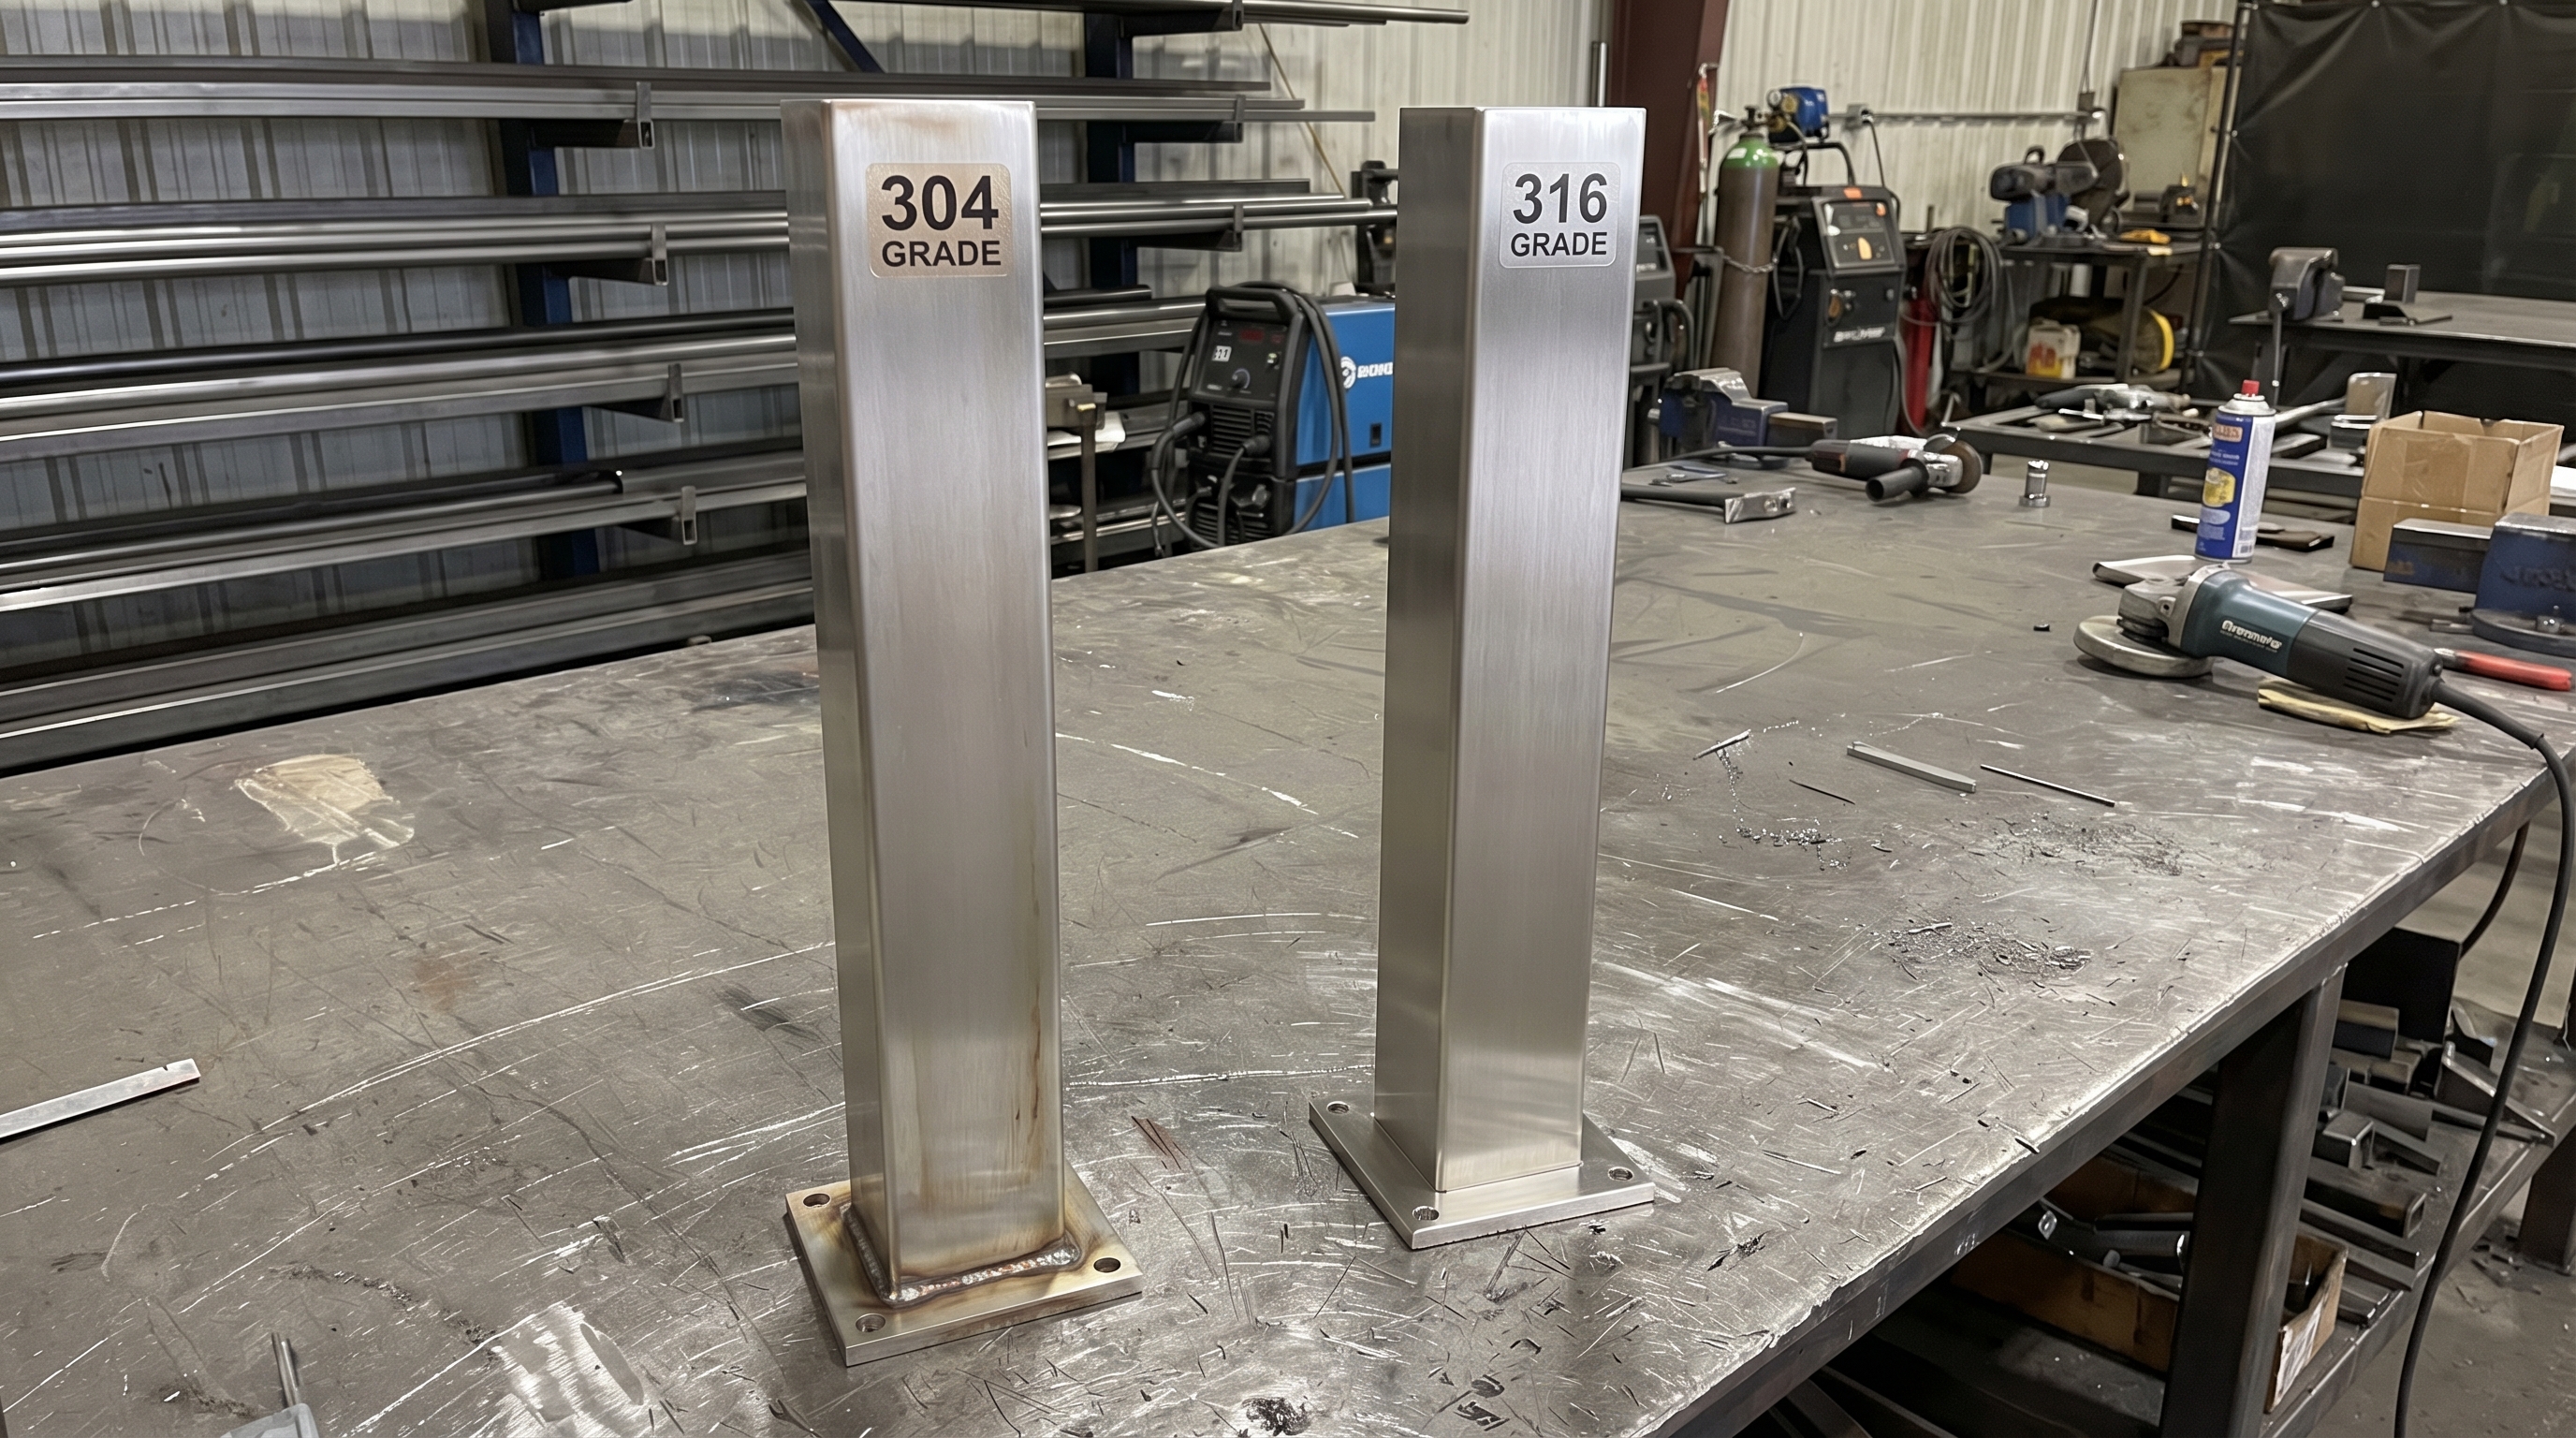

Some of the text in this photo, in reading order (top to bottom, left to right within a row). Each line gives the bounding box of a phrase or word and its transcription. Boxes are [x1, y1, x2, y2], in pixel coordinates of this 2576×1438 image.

[881, 175, 999, 230] 304
[1513, 173, 1607, 224] 316
[882, 241, 1002, 267] GRADE
[1511, 232, 1607, 257] GRADE
